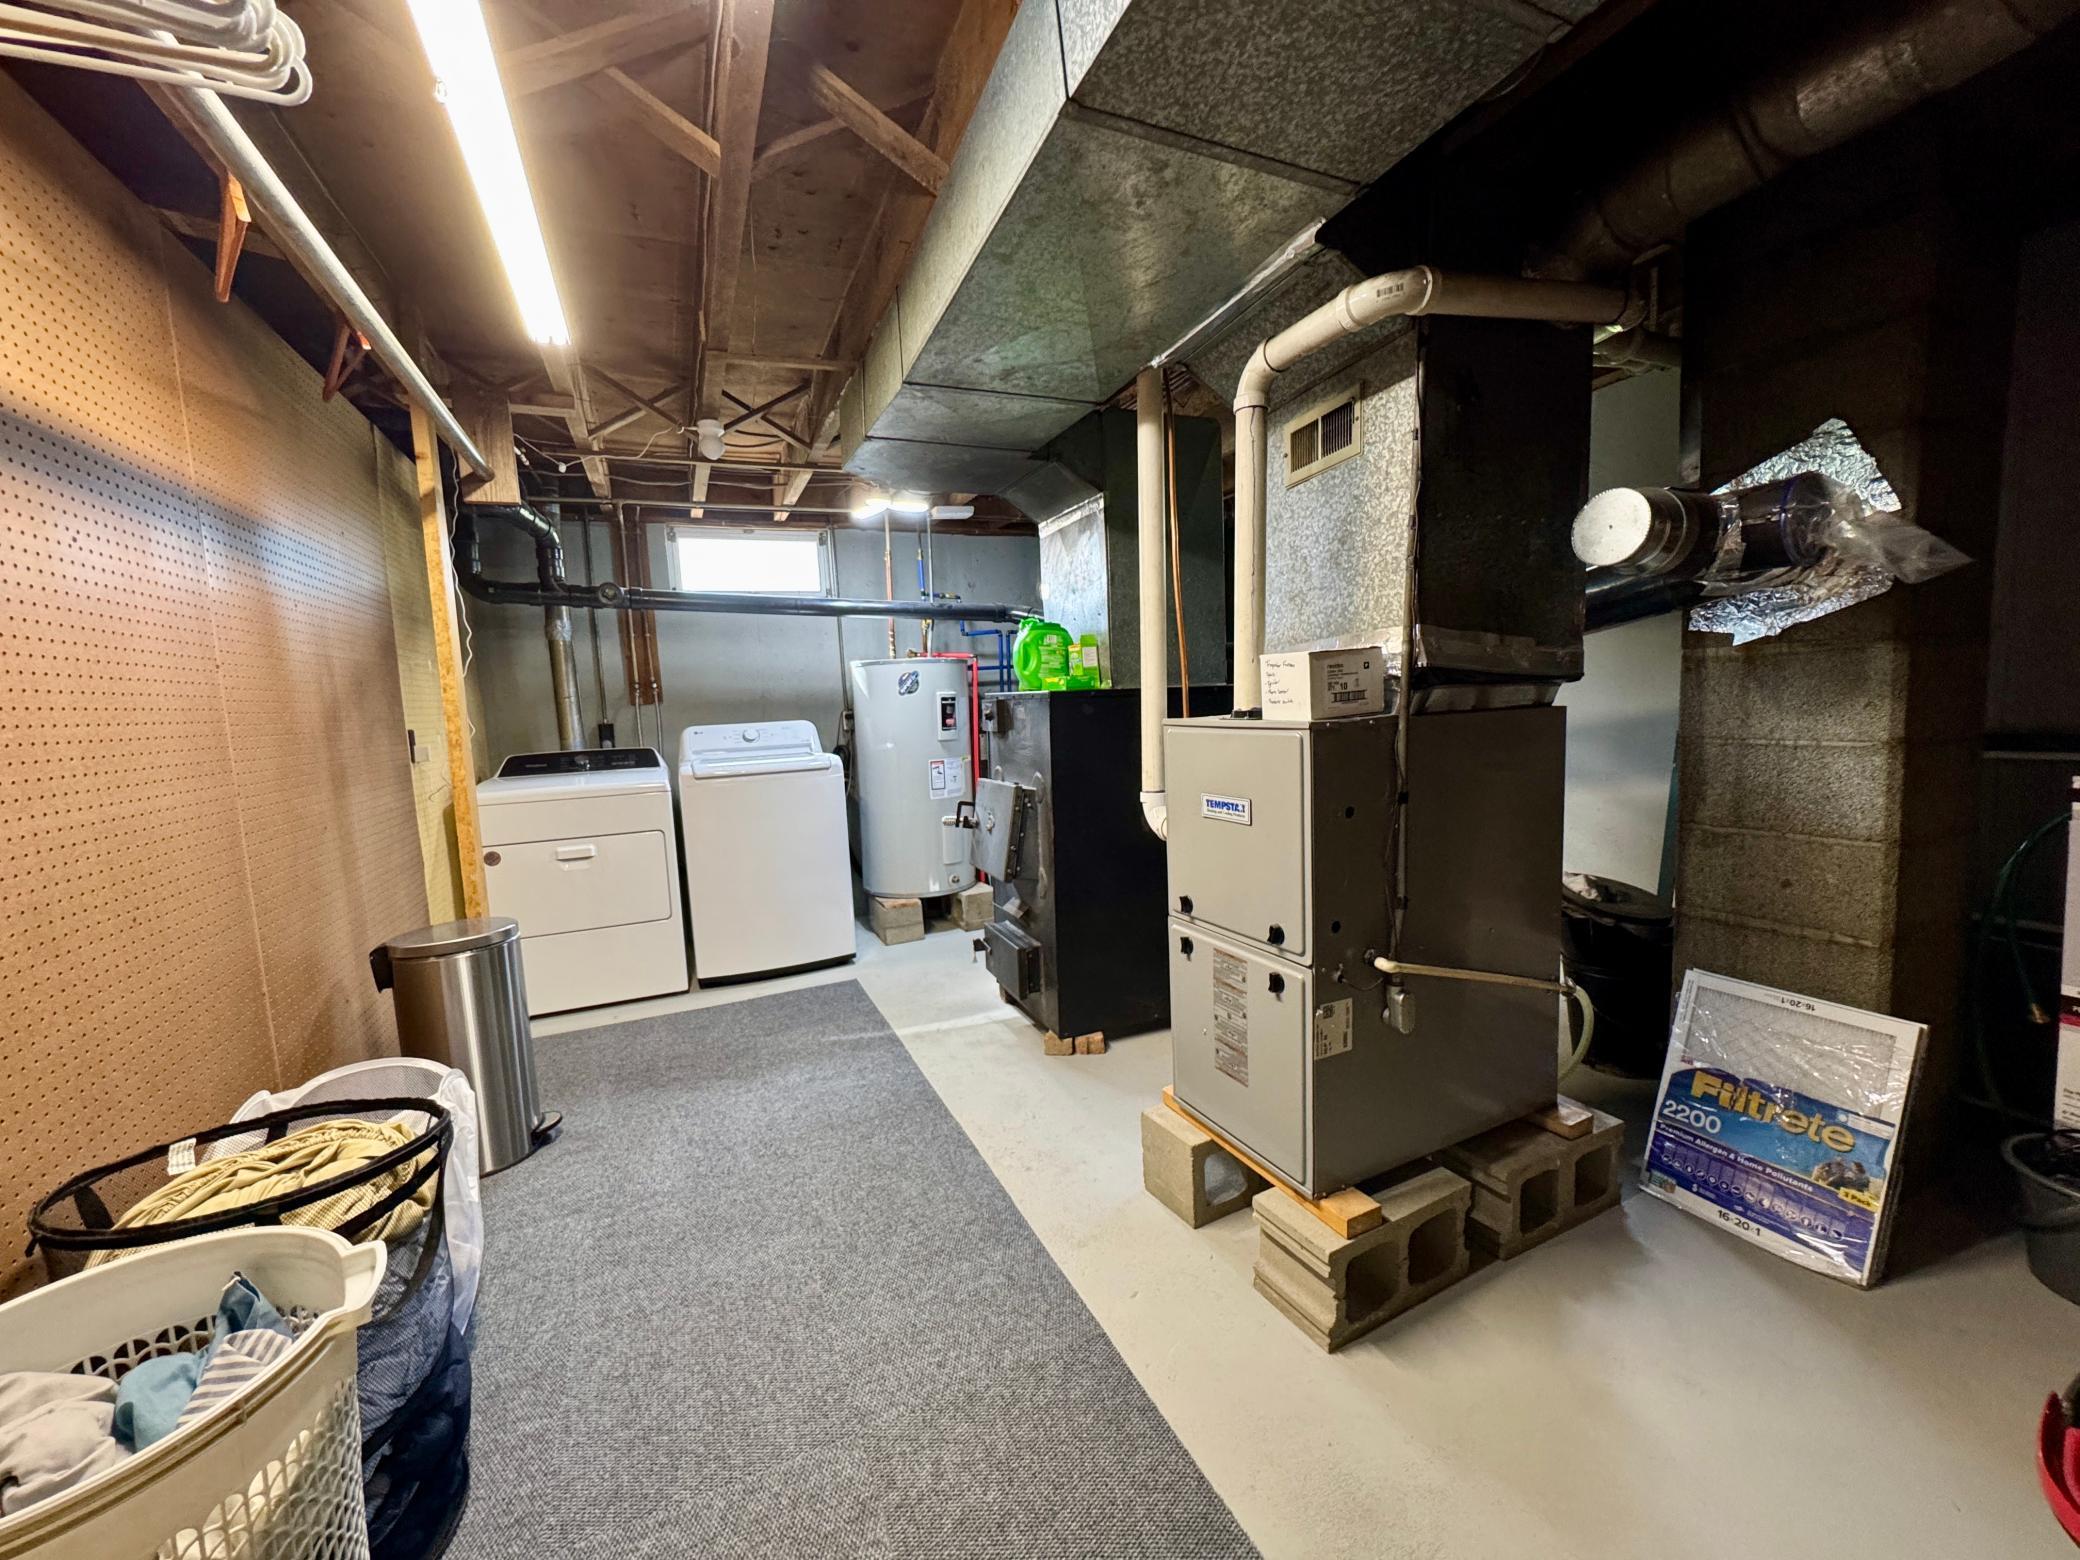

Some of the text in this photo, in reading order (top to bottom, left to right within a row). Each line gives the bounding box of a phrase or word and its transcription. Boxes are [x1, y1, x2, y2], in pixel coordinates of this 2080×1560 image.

[1662, 1099, 1722, 1134] 2200
[1690, 1070, 1856, 1153] Filtrete
[1660, 1123, 1694, 1142] Premium
[1694, 1138, 1728, 1156] Allergen
[1736, 1155, 1763, 1171] Home
[1765, 1167, 1813, 1192] Pollutants
